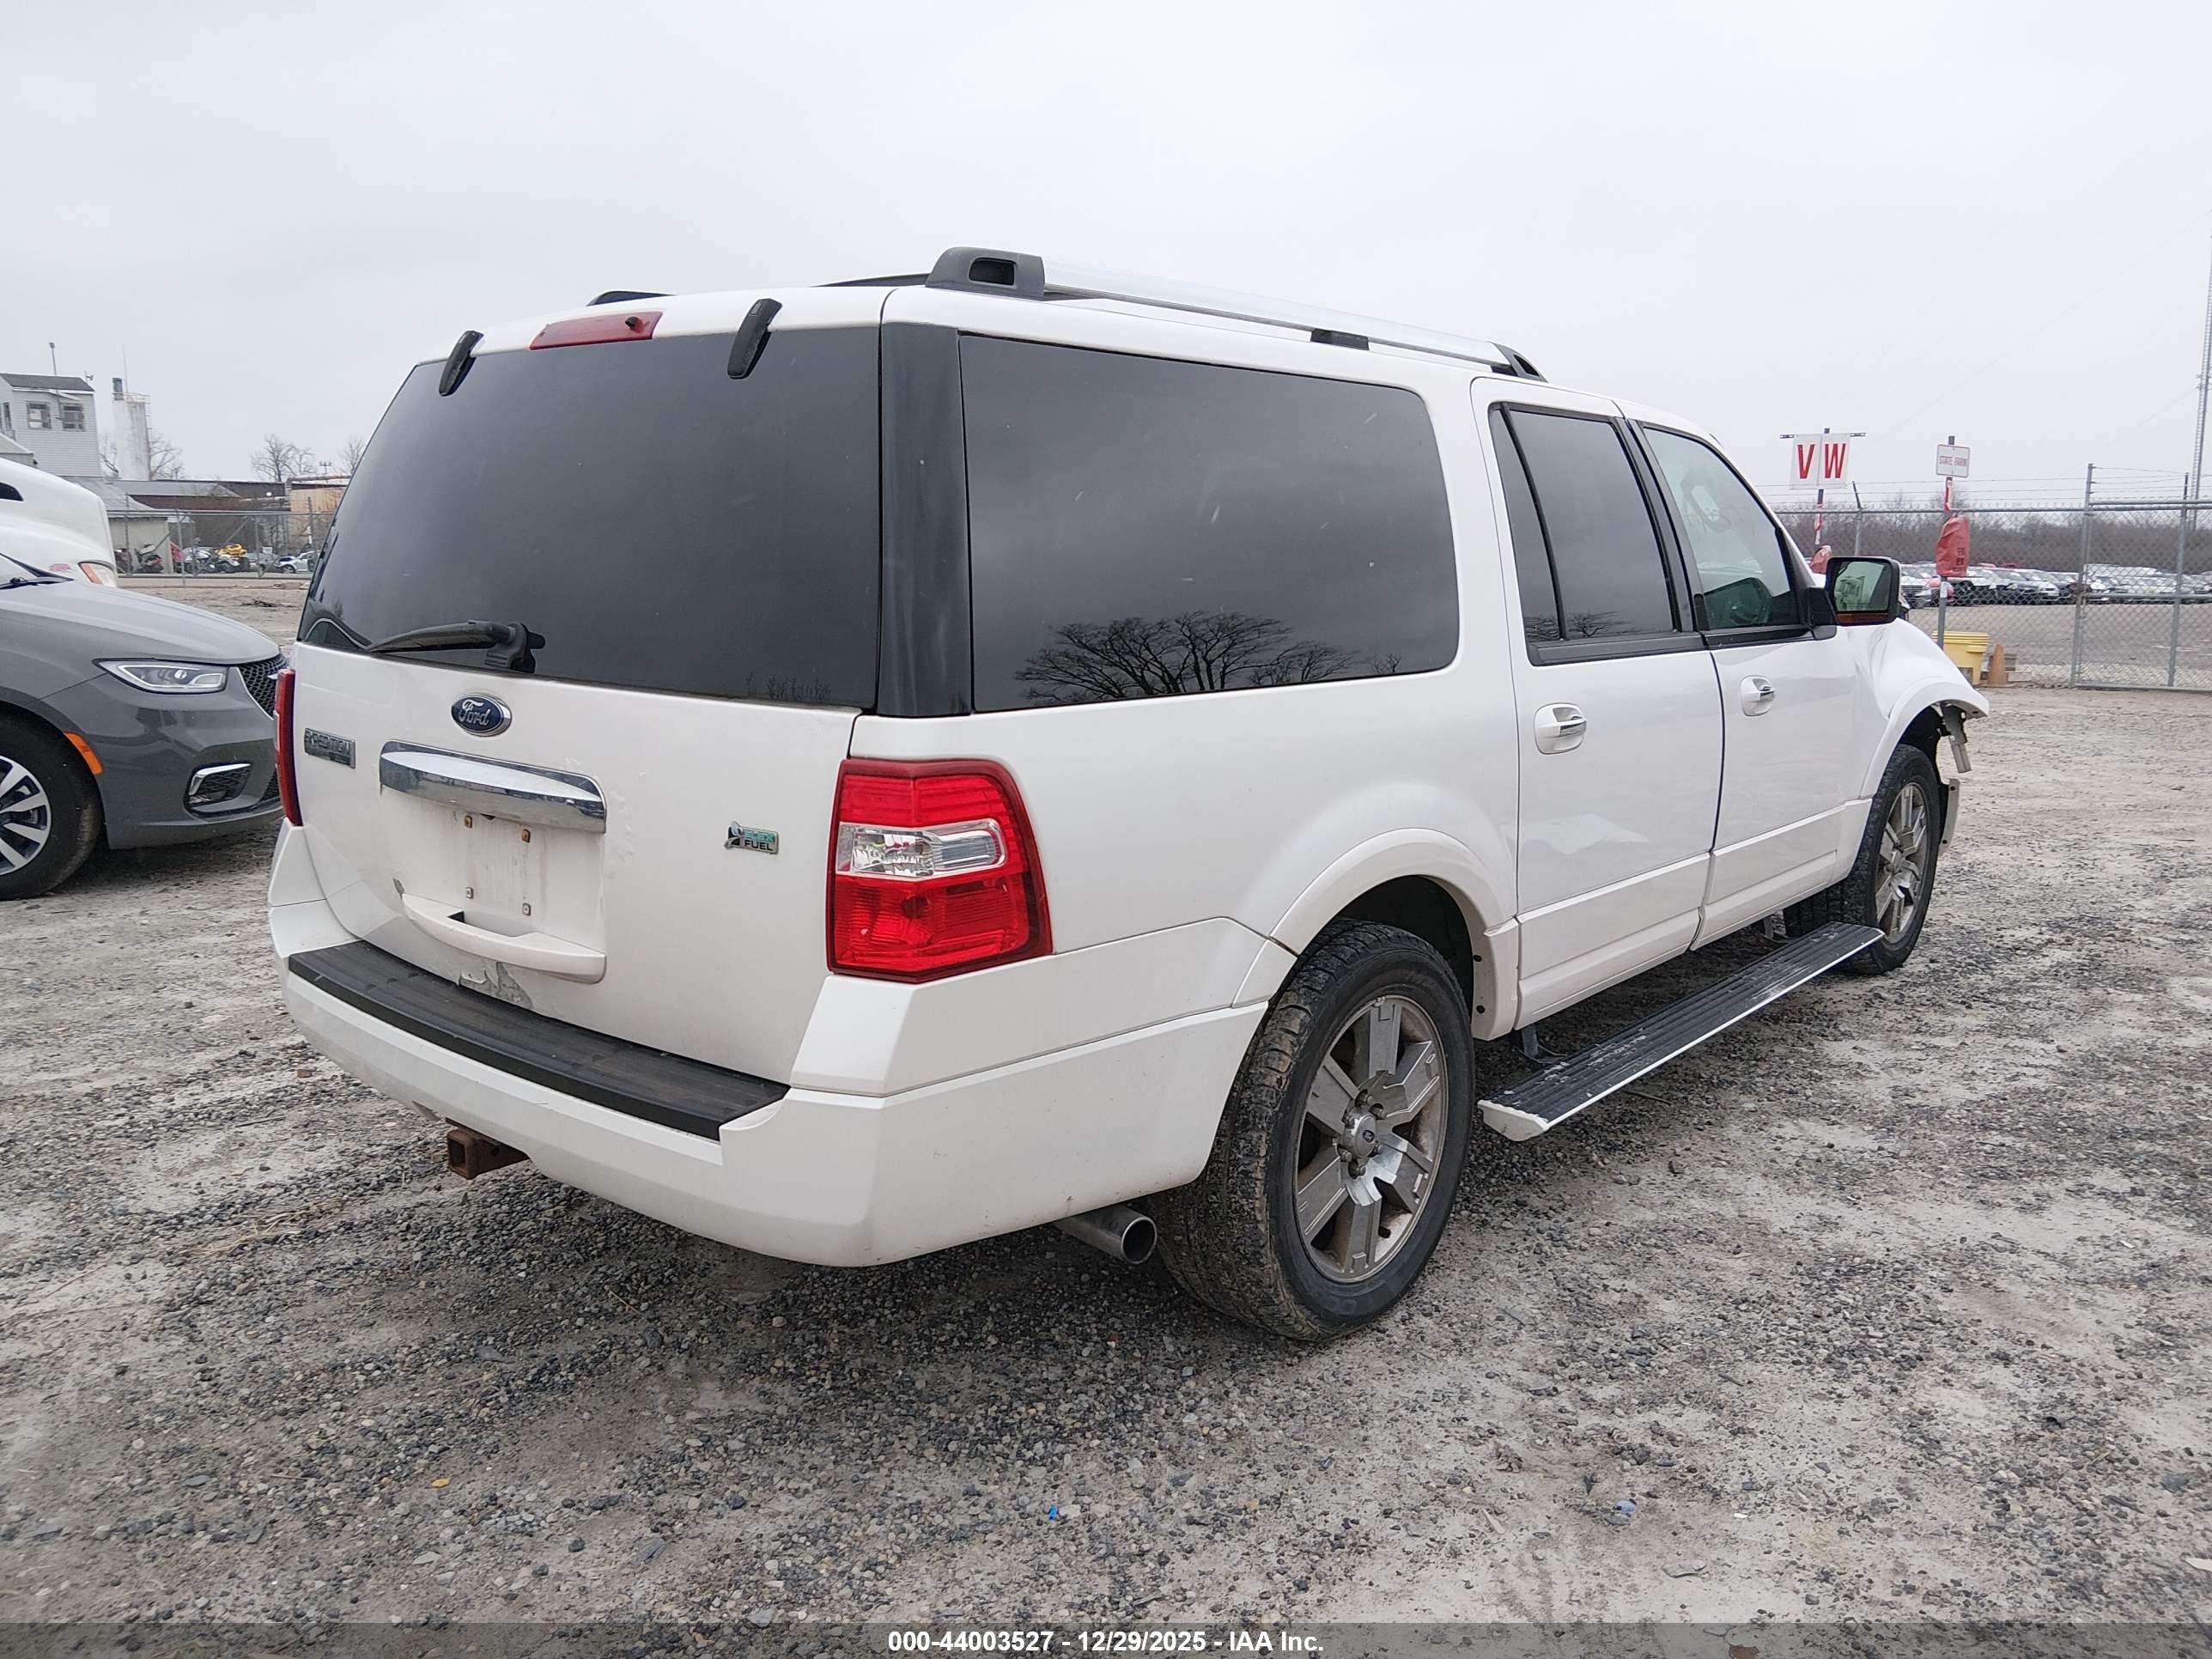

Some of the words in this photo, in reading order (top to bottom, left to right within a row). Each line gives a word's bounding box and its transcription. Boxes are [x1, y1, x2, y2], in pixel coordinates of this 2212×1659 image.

[458, 699, 492, 726] Ford
[304, 730, 352, 757] EXPEDITION
[744, 839, 774, 852] FUEL
